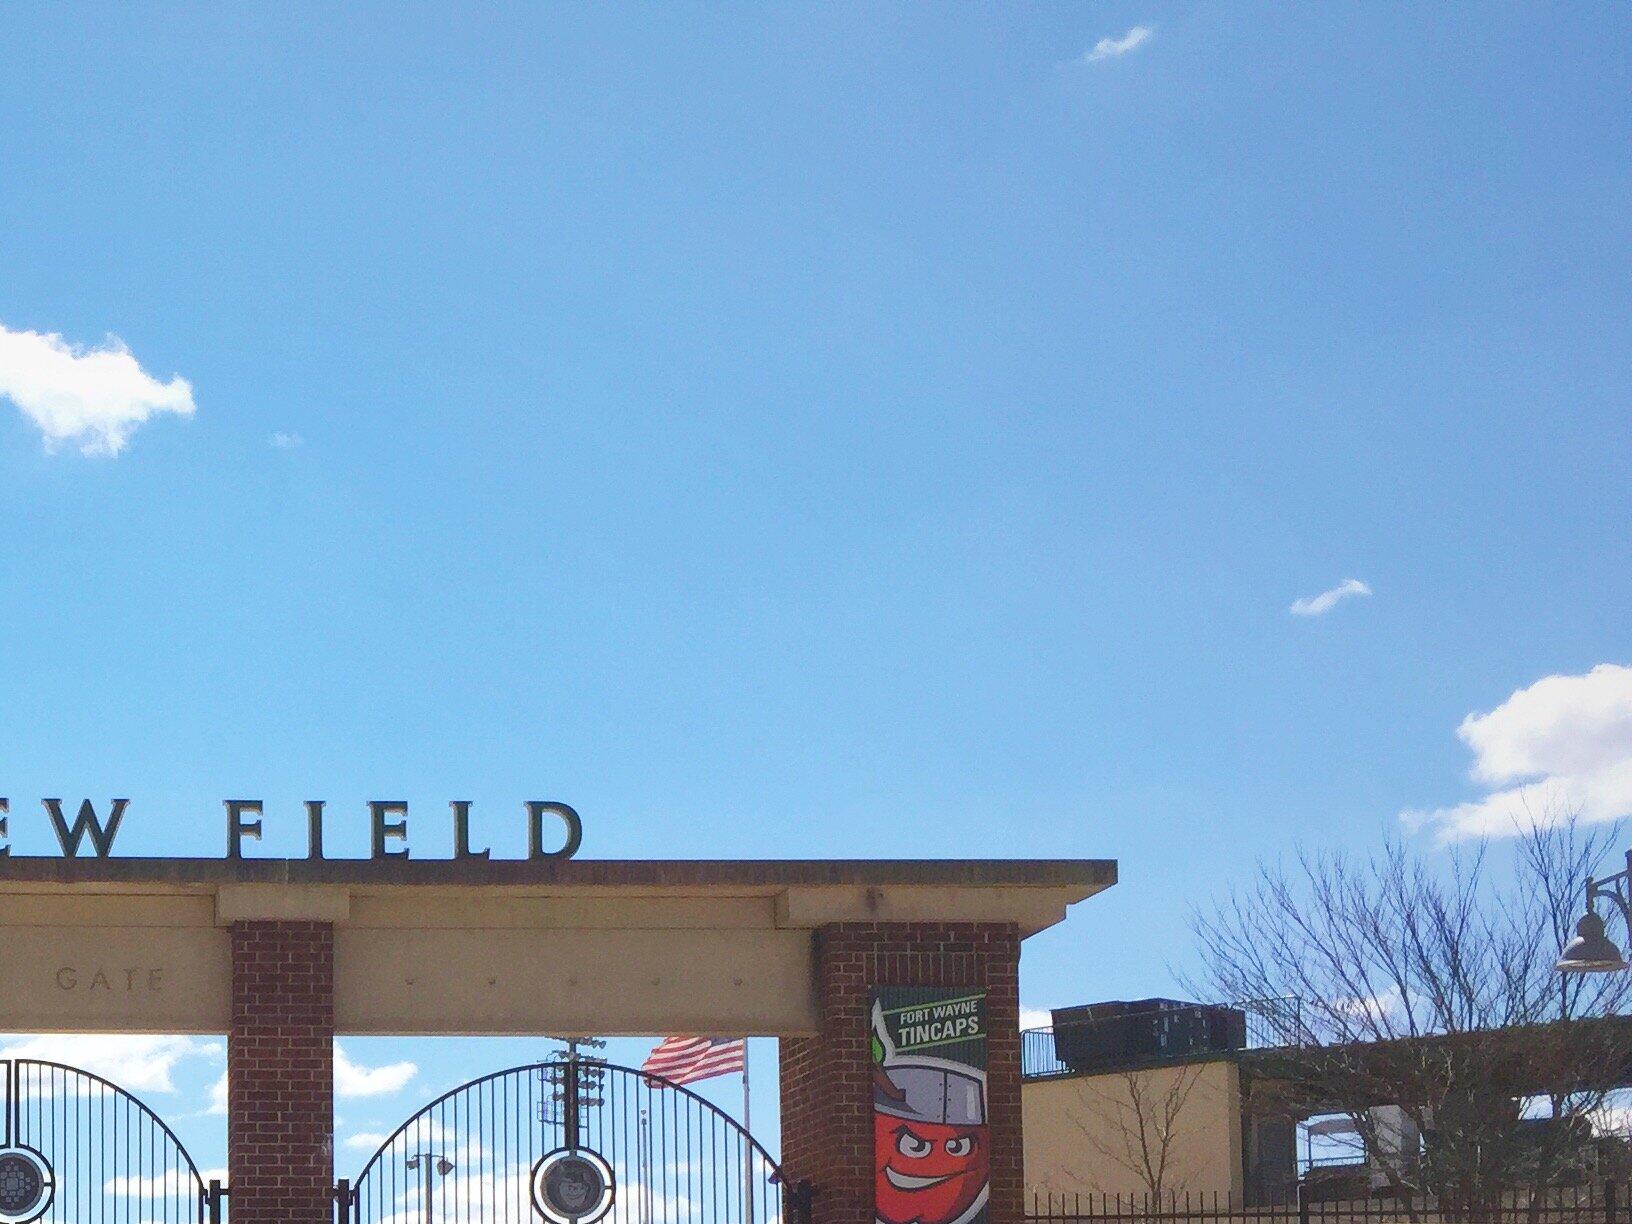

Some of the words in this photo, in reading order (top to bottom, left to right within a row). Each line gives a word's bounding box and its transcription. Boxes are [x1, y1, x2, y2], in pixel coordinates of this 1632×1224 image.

[223, 799, 583, 861] FIELD
[56, 966, 164, 991] GATE
[900, 1009, 931, 1025] FORT
[933, 1000, 978, 1020] WAYNE
[898, 1016, 980, 1047] TINCAPS
